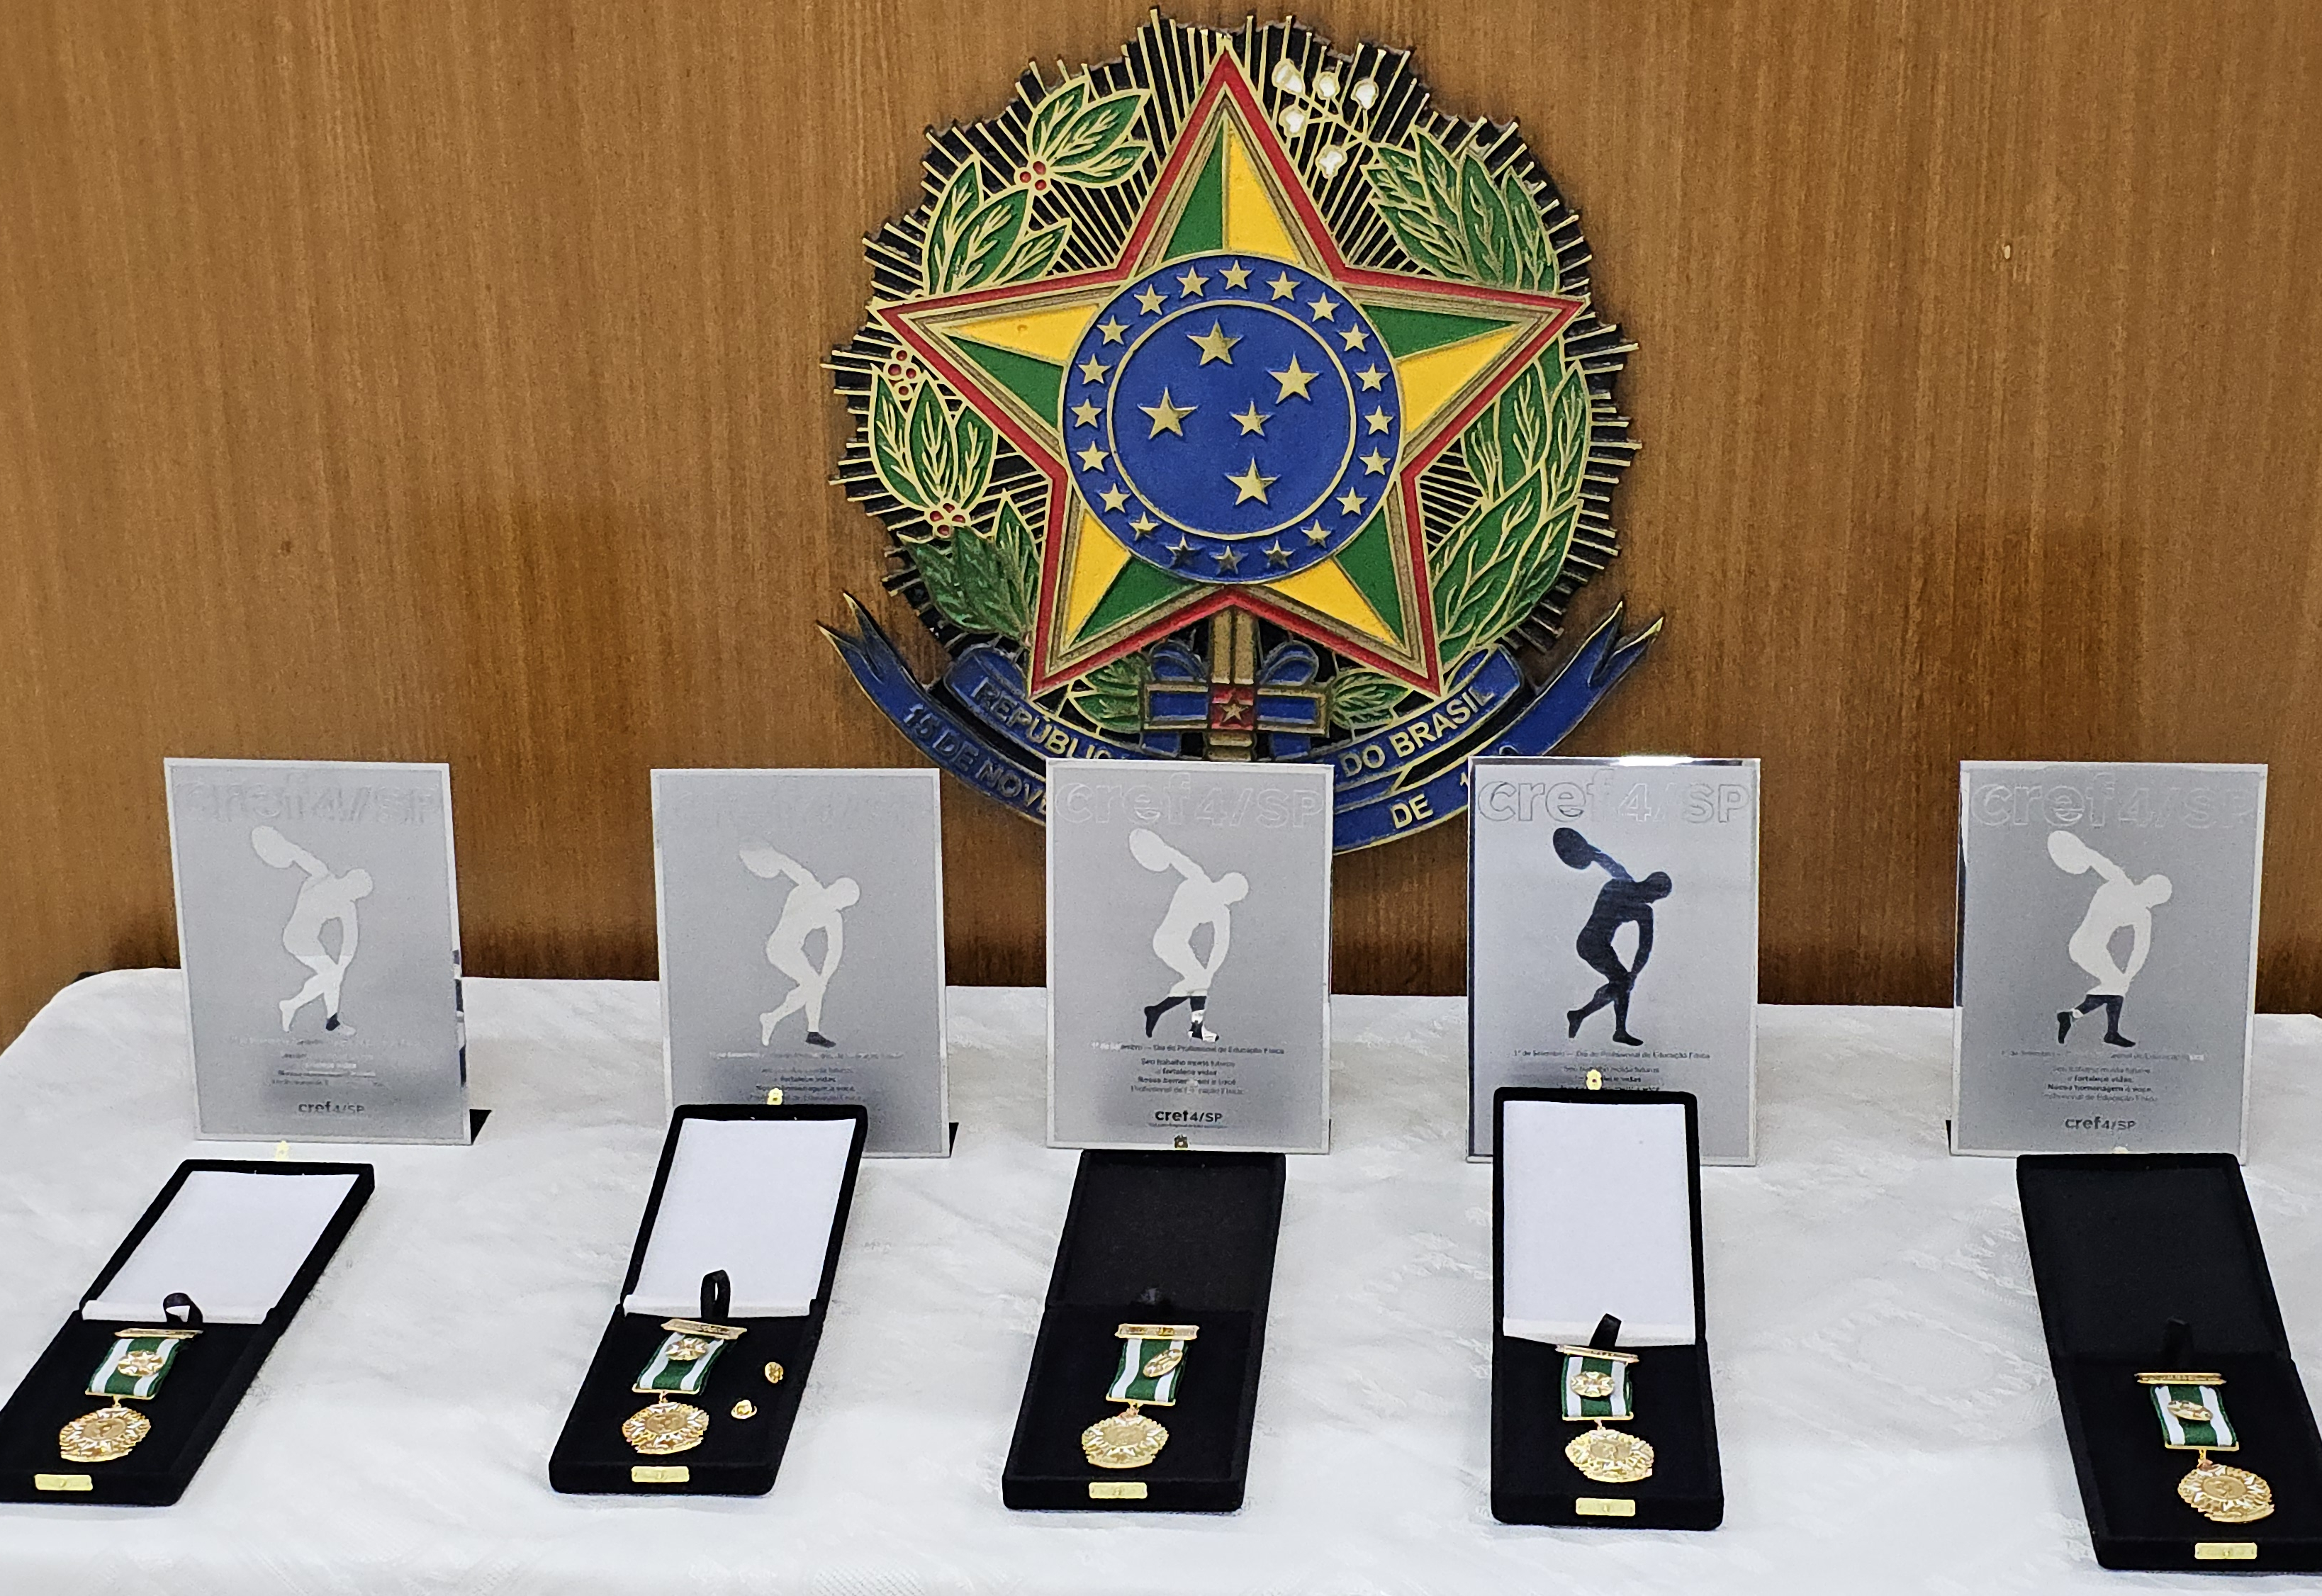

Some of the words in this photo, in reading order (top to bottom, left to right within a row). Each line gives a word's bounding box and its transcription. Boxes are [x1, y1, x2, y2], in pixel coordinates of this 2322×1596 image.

[1338, 745, 1385, 777] DO
[1389, 686, 1494, 758] BRASIL
[932, 728, 979, 771] DE
[1391, 793, 1434, 829] DE
[1155, 1109, 1223, 1123] cref4/SP
